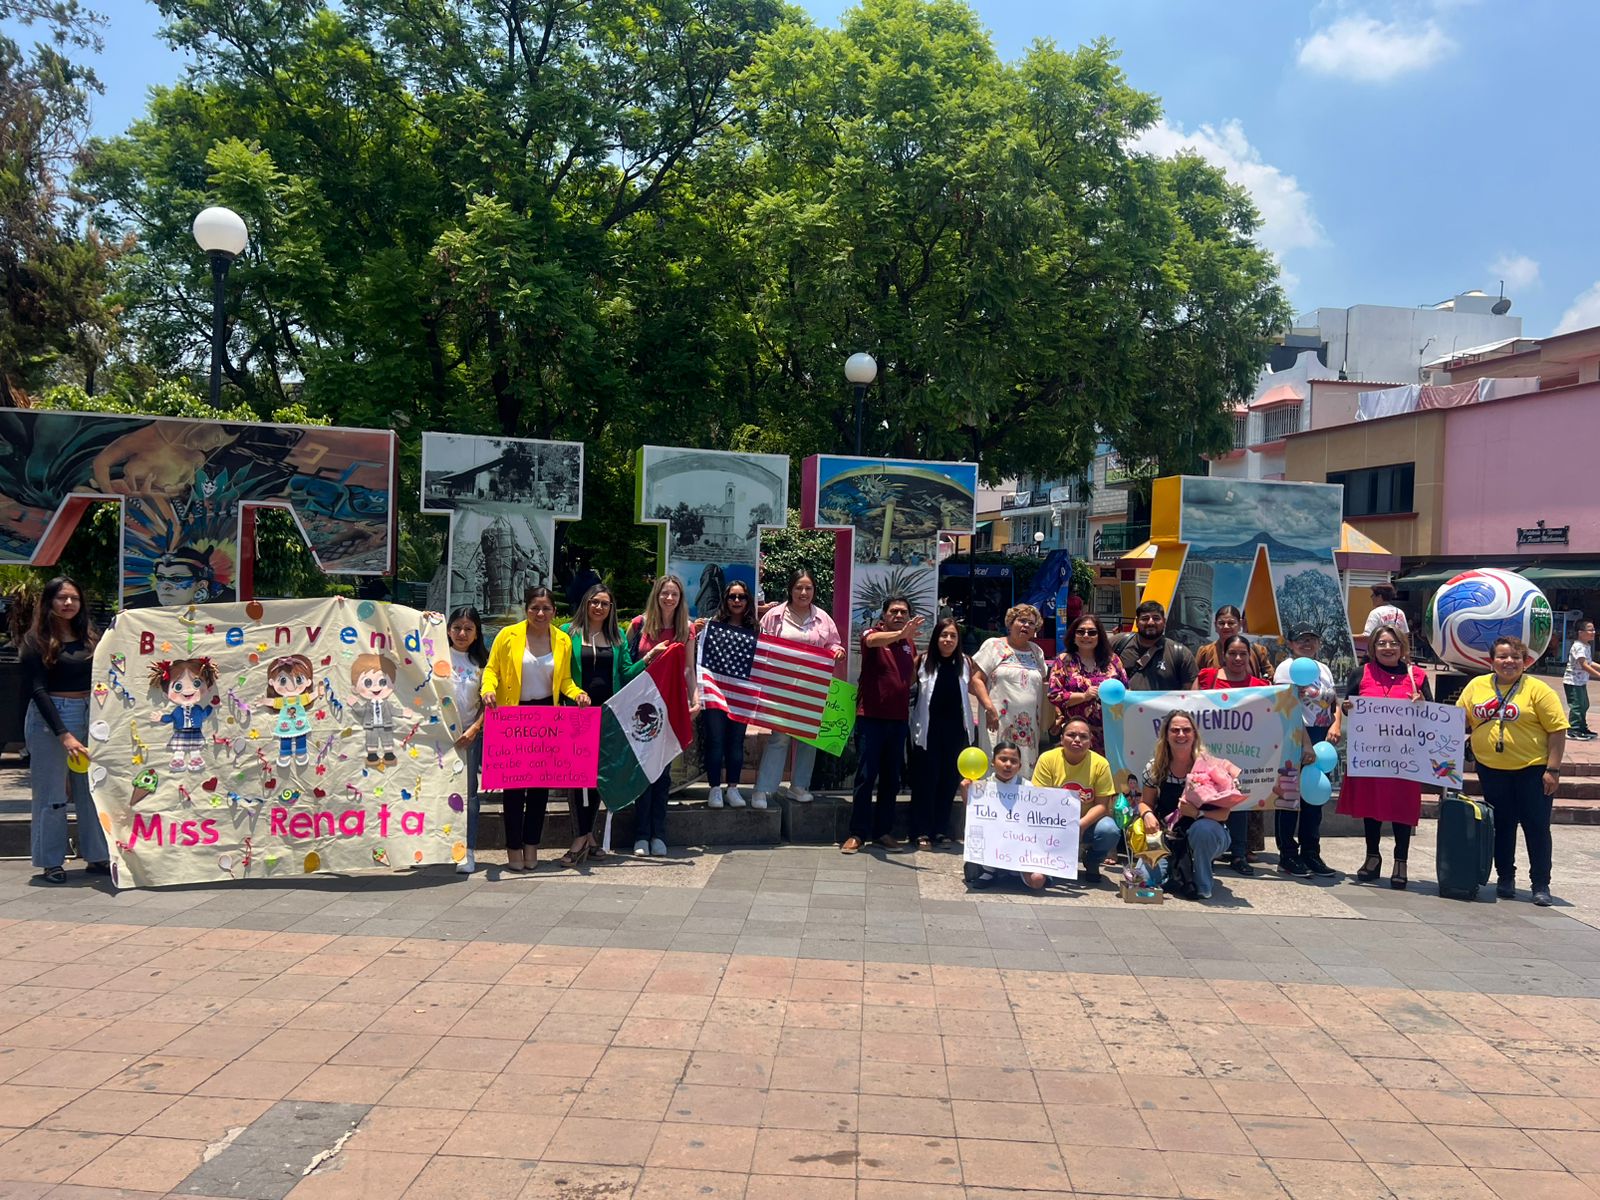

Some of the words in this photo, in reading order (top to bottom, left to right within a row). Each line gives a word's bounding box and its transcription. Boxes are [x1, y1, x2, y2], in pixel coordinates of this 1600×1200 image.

[1355, 724, 1364, 733] a
[515, 743, 561, 758] Hidalgo
[573, 744, 591, 757] los
[1226, 741, 1261, 758] SUÁREZ
[1354, 740, 1391, 754] tierra
[1400, 744, 1415, 755] de
[485, 758, 522, 770] recibe
[529, 759, 547, 769] con
[554, 757, 572, 769] los
[539, 770, 589, 783] abiertos
[1060, 797, 1071, 807] a
[973, 804, 997, 819] Tula
[1005, 809, 1020, 822] de
[1027, 810, 1067, 828] Allende
[128, 814, 219, 849] Miss
[270, 804, 425, 839] Renata
[1002, 830, 1038, 844] ciudad
[1046, 835, 1060, 847] de
[995, 847, 1012, 862] los
